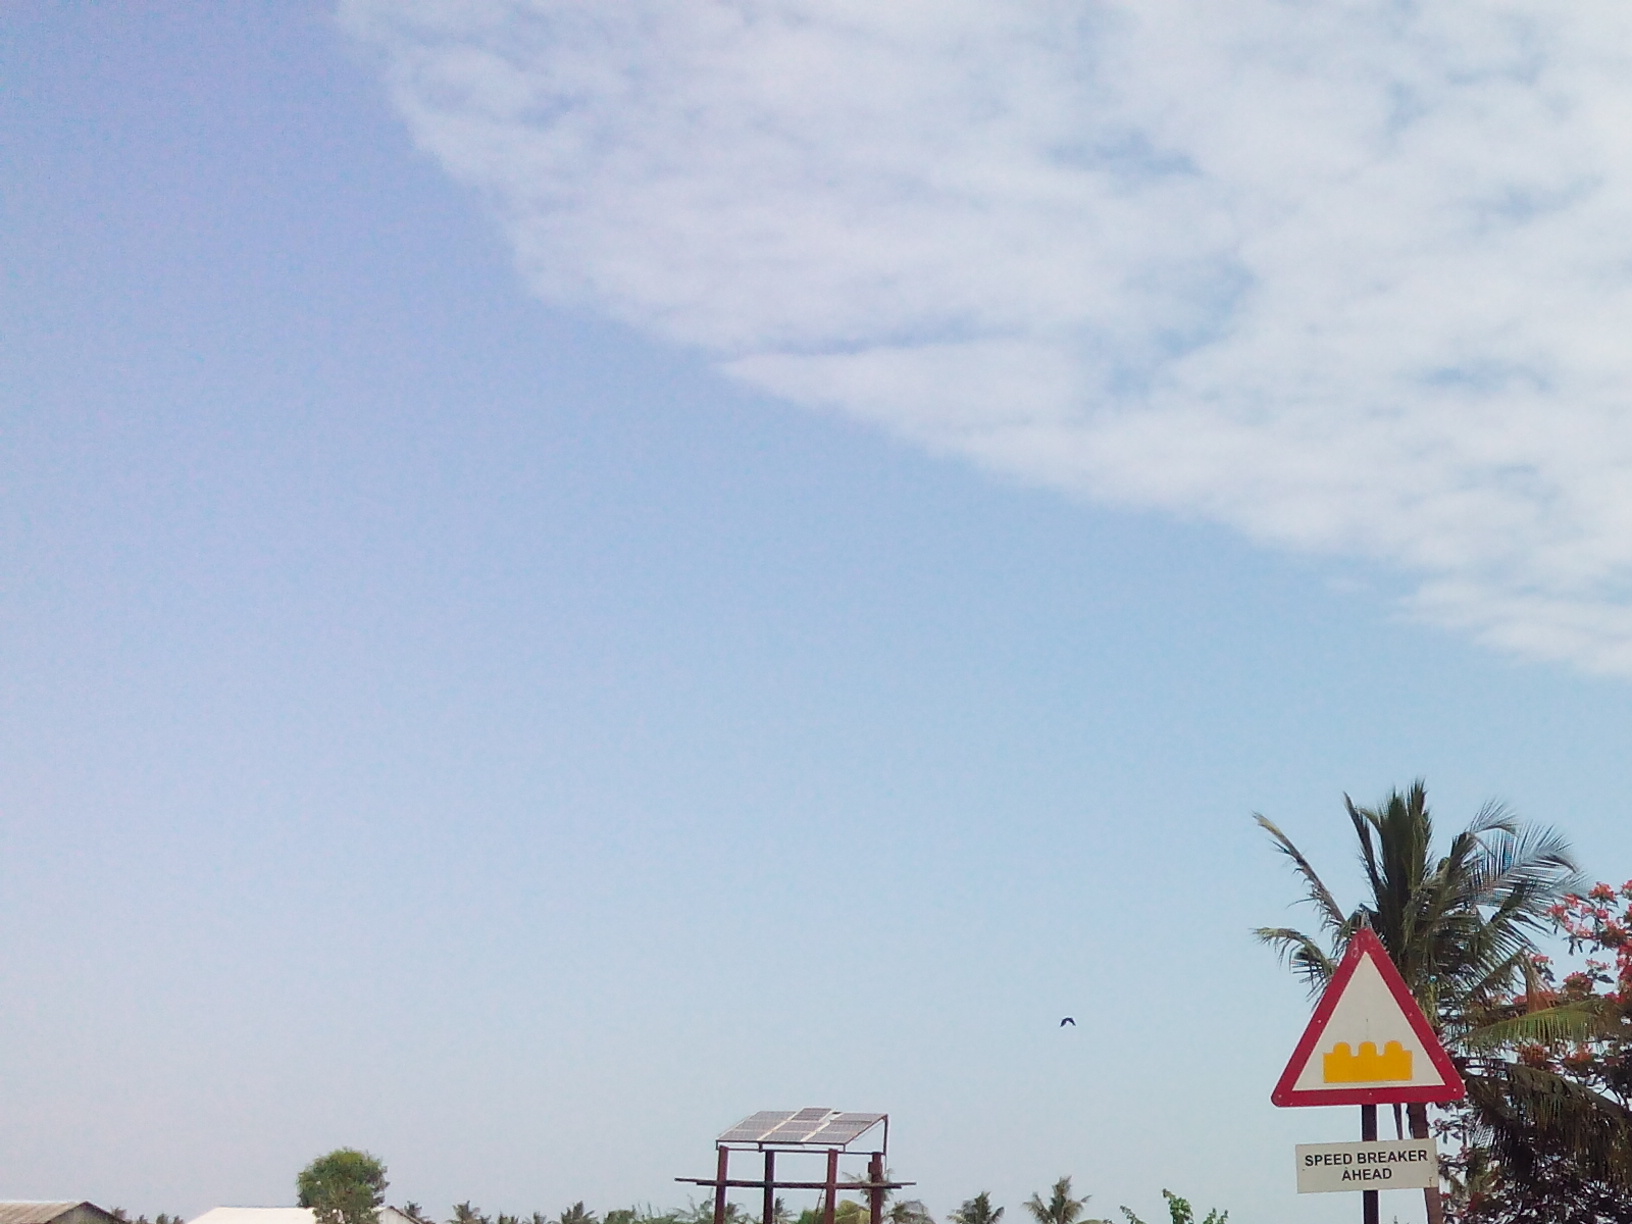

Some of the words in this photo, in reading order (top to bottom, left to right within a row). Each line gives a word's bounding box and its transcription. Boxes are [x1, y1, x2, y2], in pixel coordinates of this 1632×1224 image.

[1304, 1153, 1353, 1167] SPEED
[1357, 1149, 1428, 1164] BREAKER
[1341, 1168, 1393, 1181] AHEAD
